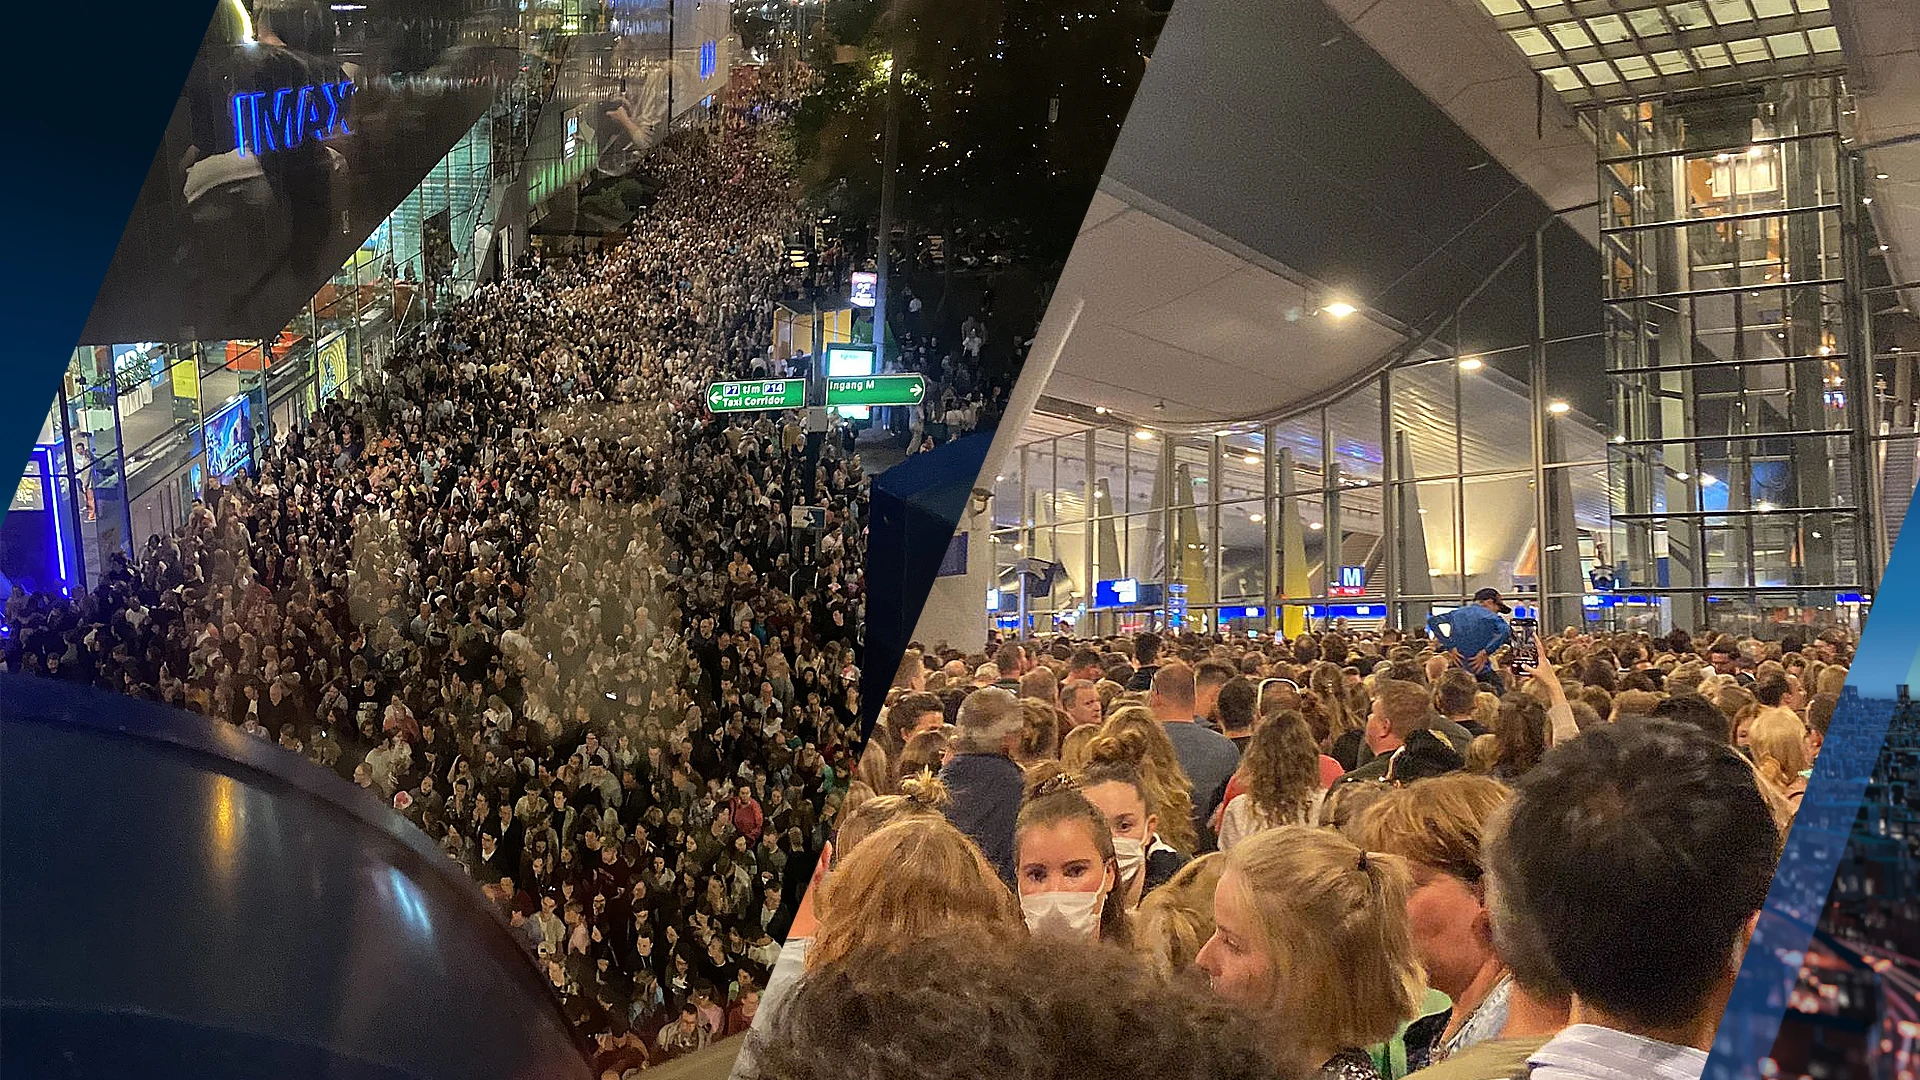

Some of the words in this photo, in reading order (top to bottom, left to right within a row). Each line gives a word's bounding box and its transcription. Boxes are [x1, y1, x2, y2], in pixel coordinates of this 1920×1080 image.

[233, 80, 356, 158] IMAX
[724, 385, 739, 396] P7
[743, 384, 760, 395] t/m
[764, 383, 783, 393] P14
[829, 380, 863, 391] Ingang
[865, 380, 875, 389] M
[722, 397, 742, 407] Taxi
[744, 396, 785, 406] Corridor
[1343, 567, 1361, 586] M
